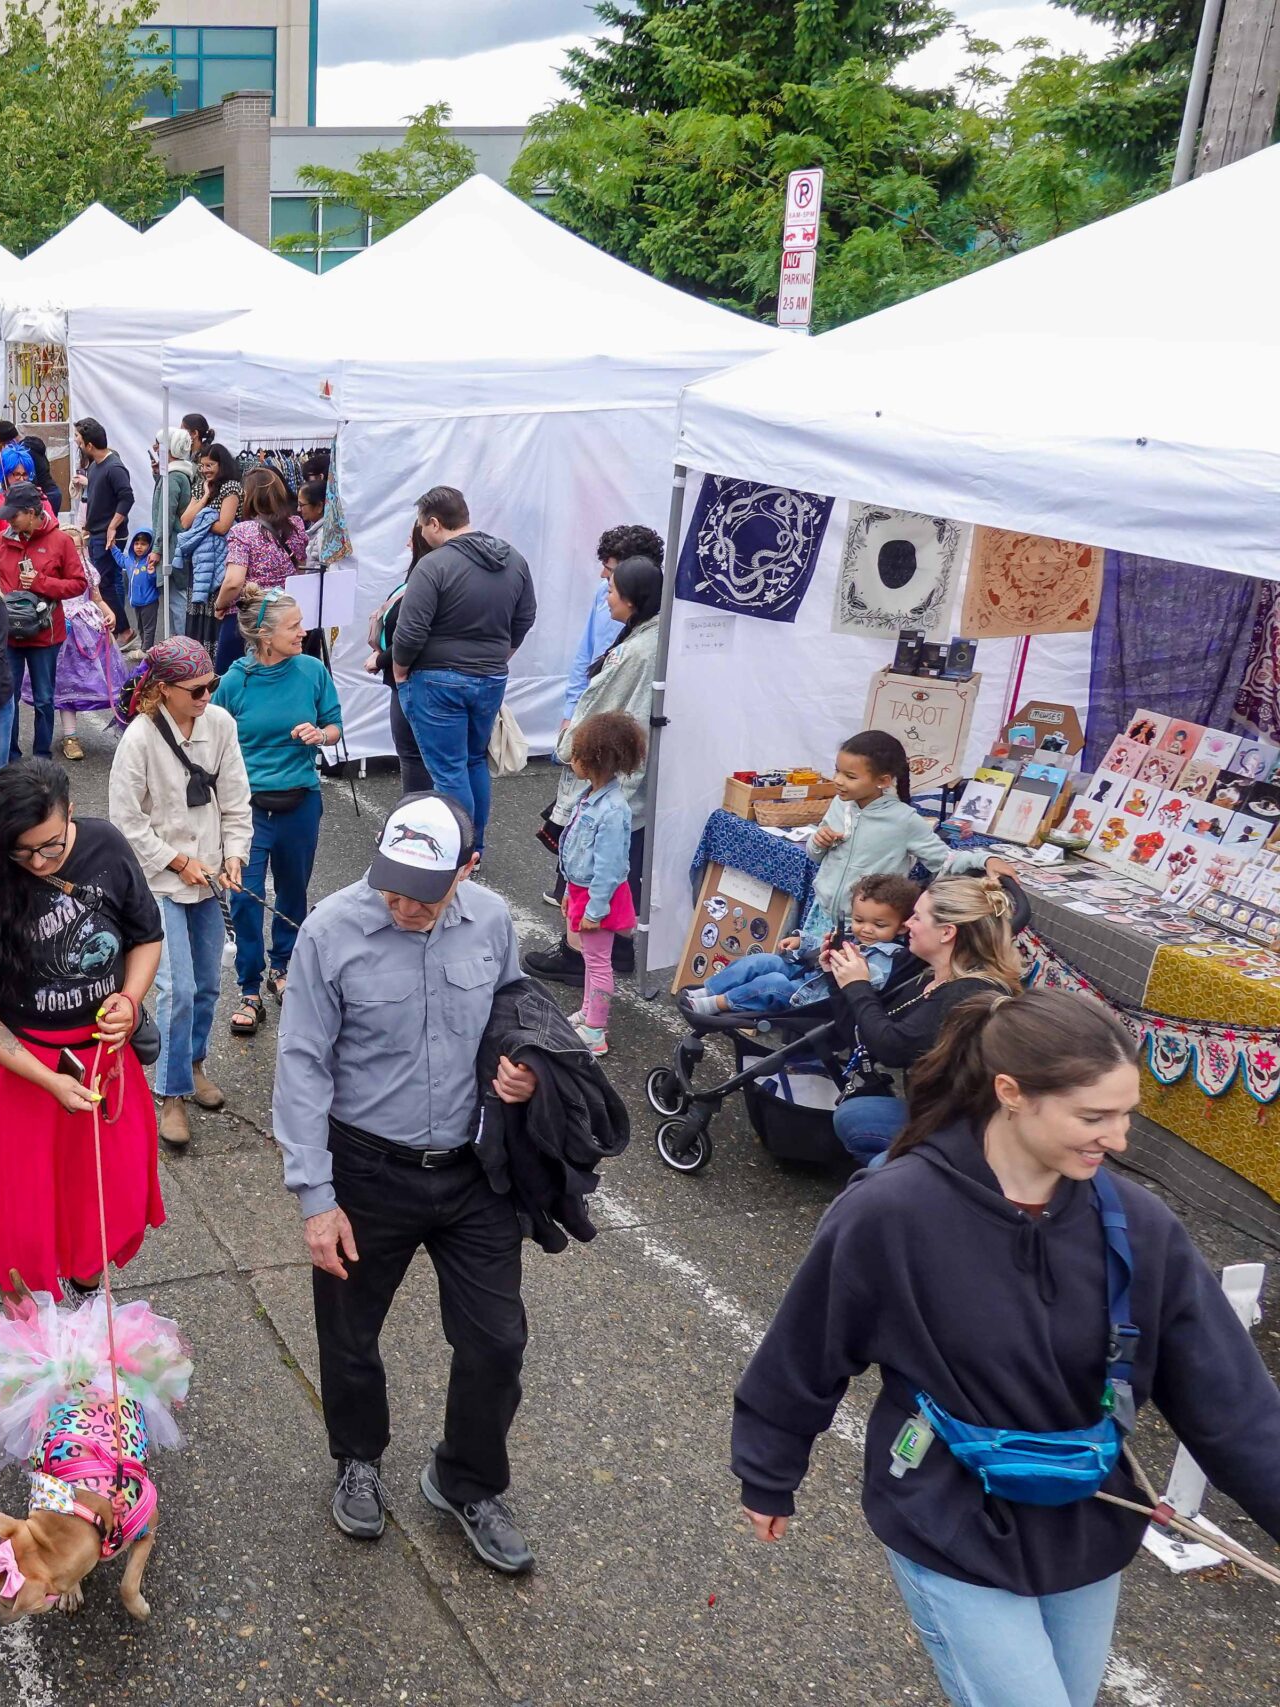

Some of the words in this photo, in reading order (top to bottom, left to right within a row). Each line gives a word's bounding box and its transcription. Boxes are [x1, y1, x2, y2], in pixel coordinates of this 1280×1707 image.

[786, 253, 800, 267] NO
[784, 273, 811, 285] PARKING
[783, 297, 794, 310] 2-5
[796, 297, 808, 310] AM
[889, 700, 949, 726] TAROT
[1195, 906, 1220, 920] MEOW
[1222, 918, 1246, 932] MEOW
[1248, 929, 1274, 943] MEOW
[35, 987, 83, 1012] WORLD
[88, 975, 116, 998] TOUR
